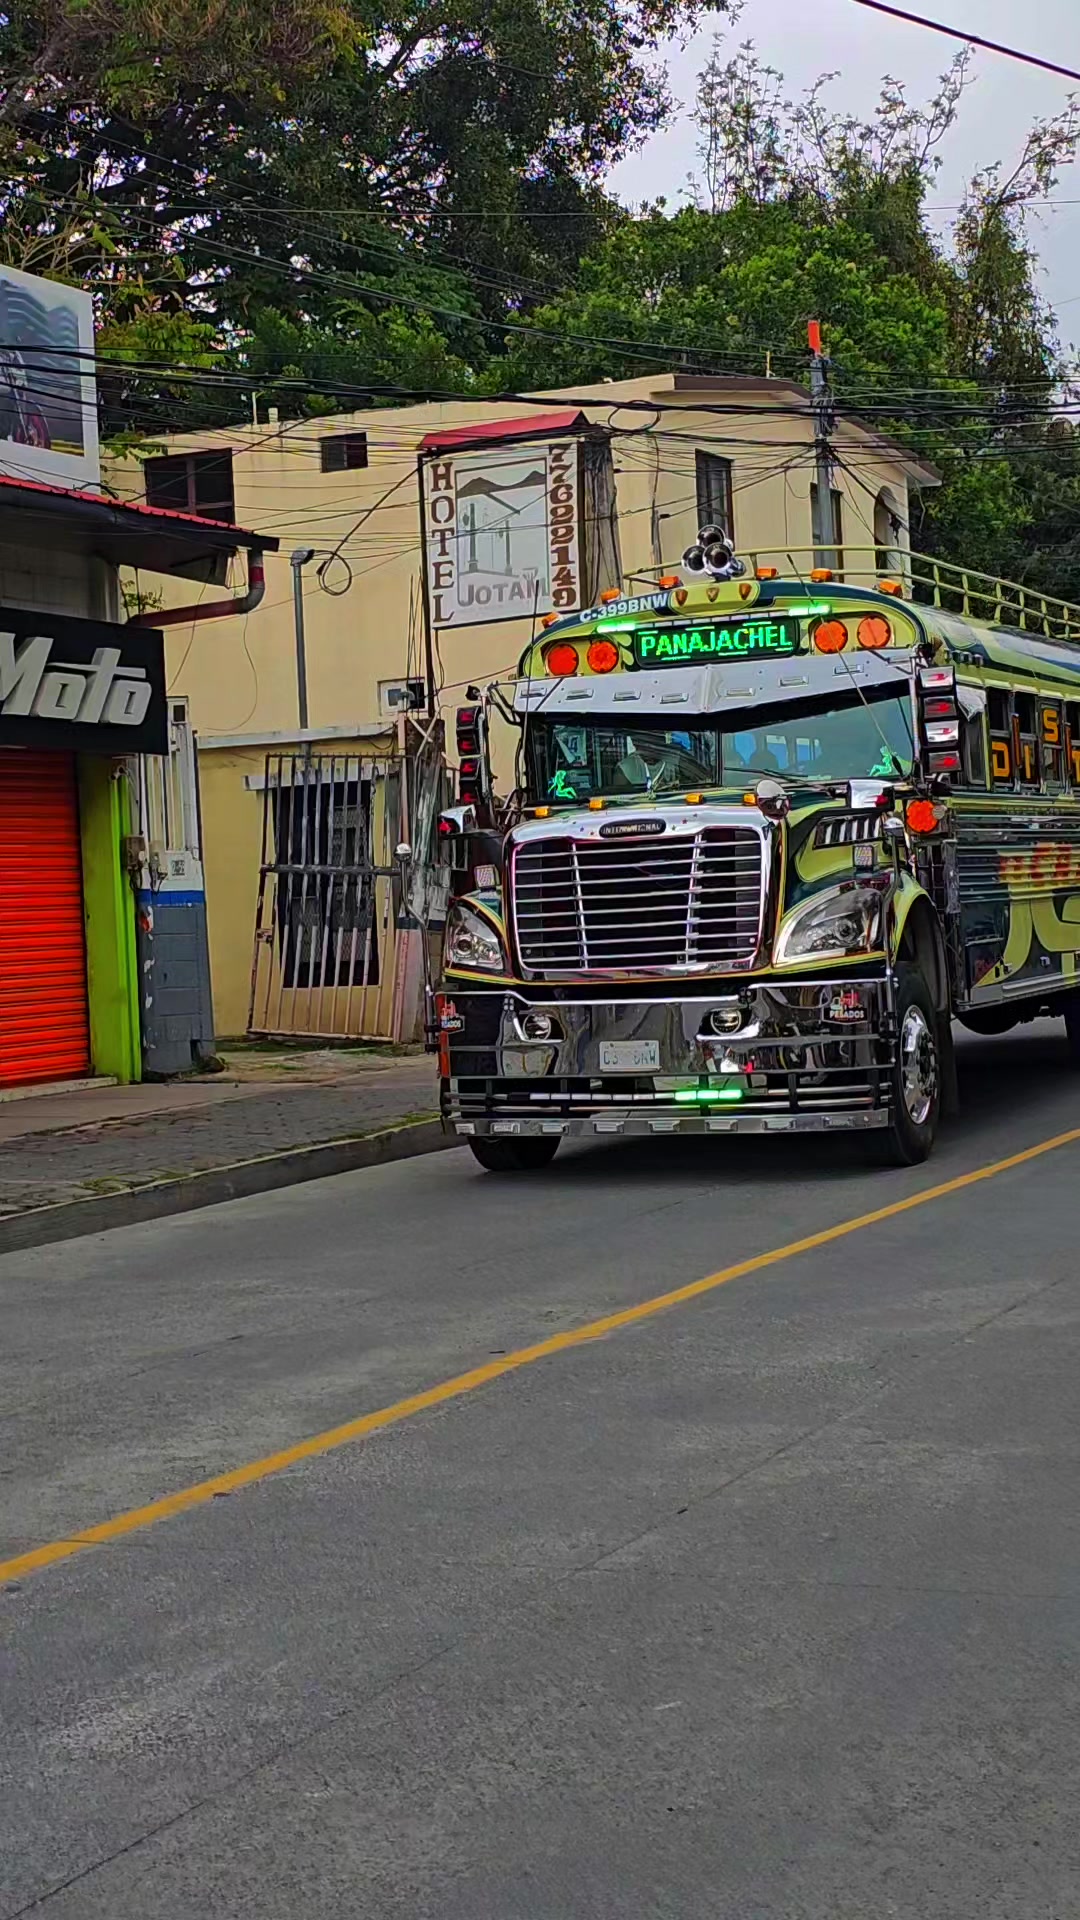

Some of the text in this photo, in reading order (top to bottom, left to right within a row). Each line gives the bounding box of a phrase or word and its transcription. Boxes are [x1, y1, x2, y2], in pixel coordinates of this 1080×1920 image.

[430, 461, 455, 623] HOTEL
[579, 592, 670, 623] C-399BNW
[640, 624, 793, 657] PANAJACHEL
[0, 631, 152, 726] Moto
